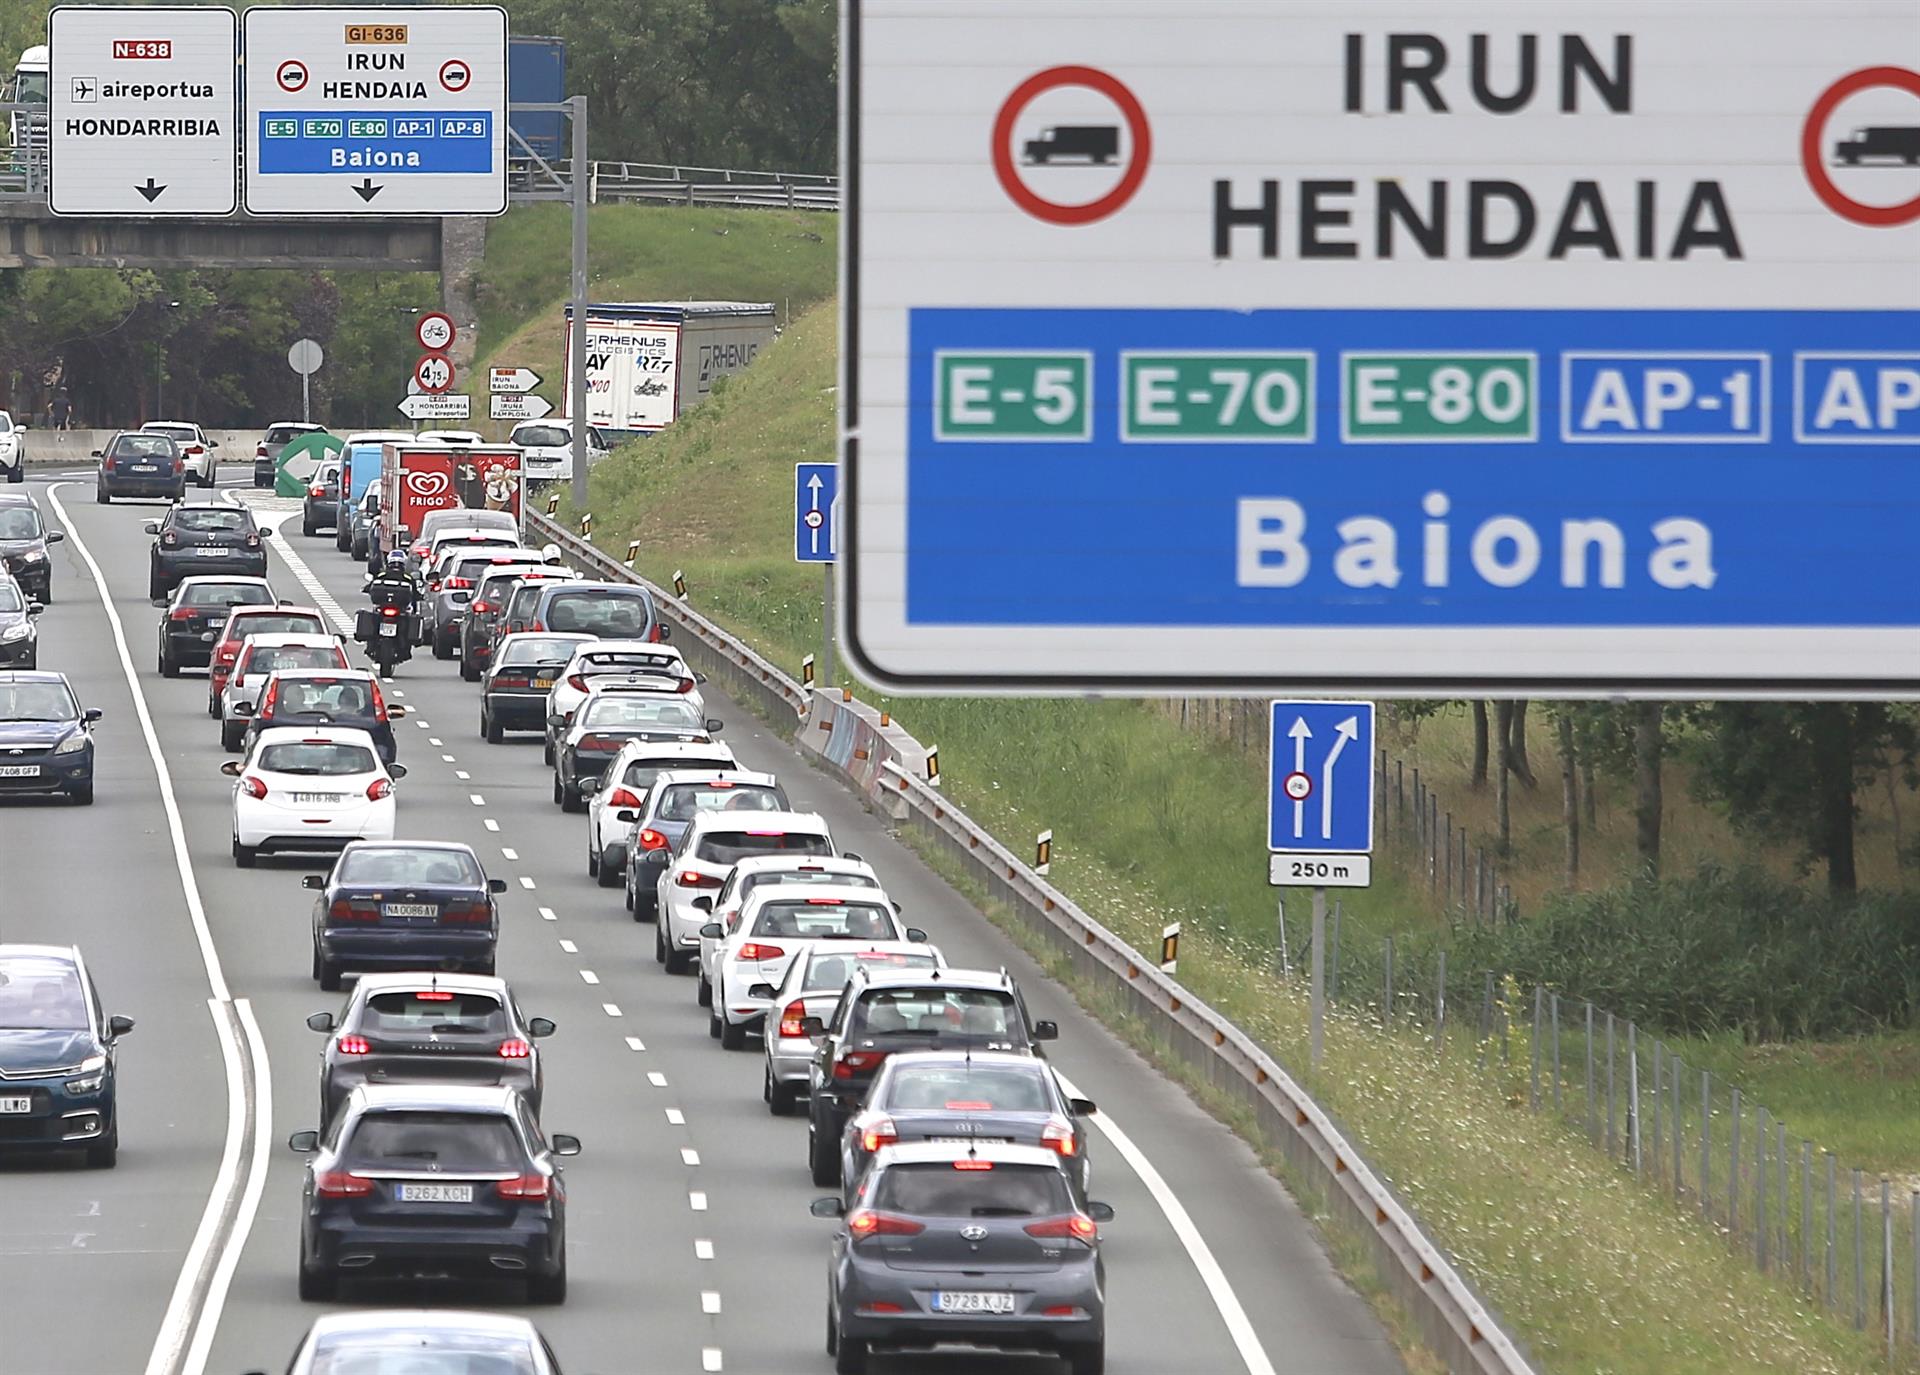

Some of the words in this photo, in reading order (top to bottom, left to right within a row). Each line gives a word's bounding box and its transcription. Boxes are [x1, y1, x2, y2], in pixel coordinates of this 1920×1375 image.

[348, 28, 405, 41] GI-636
[115, 43, 169, 57] N-638
[347, 53, 405, 70] IRUN
[1343, 33, 1634, 115] IRUN
[103, 81, 214, 101] aireportua
[323, 82, 428, 99] HENDAIA
[66, 119, 220, 136] HONDARRIBIA
[268, 122, 295, 135] E-5
[306, 122, 339, 135] E-70
[351, 122, 385, 135] E-80
[397, 122, 431, 135] AP-1
[445, 122, 483, 135] AP-8
[331, 147, 420, 167] Baiona
[1213, 178, 1745, 261] HENDAIA
[598, 335, 667, 348] RHENUS
[946, 366, 1079, 429] E-5
[1134, 367, 1303, 429] E-70
[1354, 367, 1526, 429] E-80
[1581, 367, 1753, 431] AP-1
[409, 496, 444, 506] FRIGO
[1237, 491, 1718, 591] Baiona
[1291, 862, 1328, 878] 250
[1334, 866, 1349, 878] m
[405, 1187, 440, 1200] 9262
[443, 1187, 470, 1201] KCH
[942, 1294, 978, 1309] 9728
[984, 1294, 1012, 1309] KJZ
